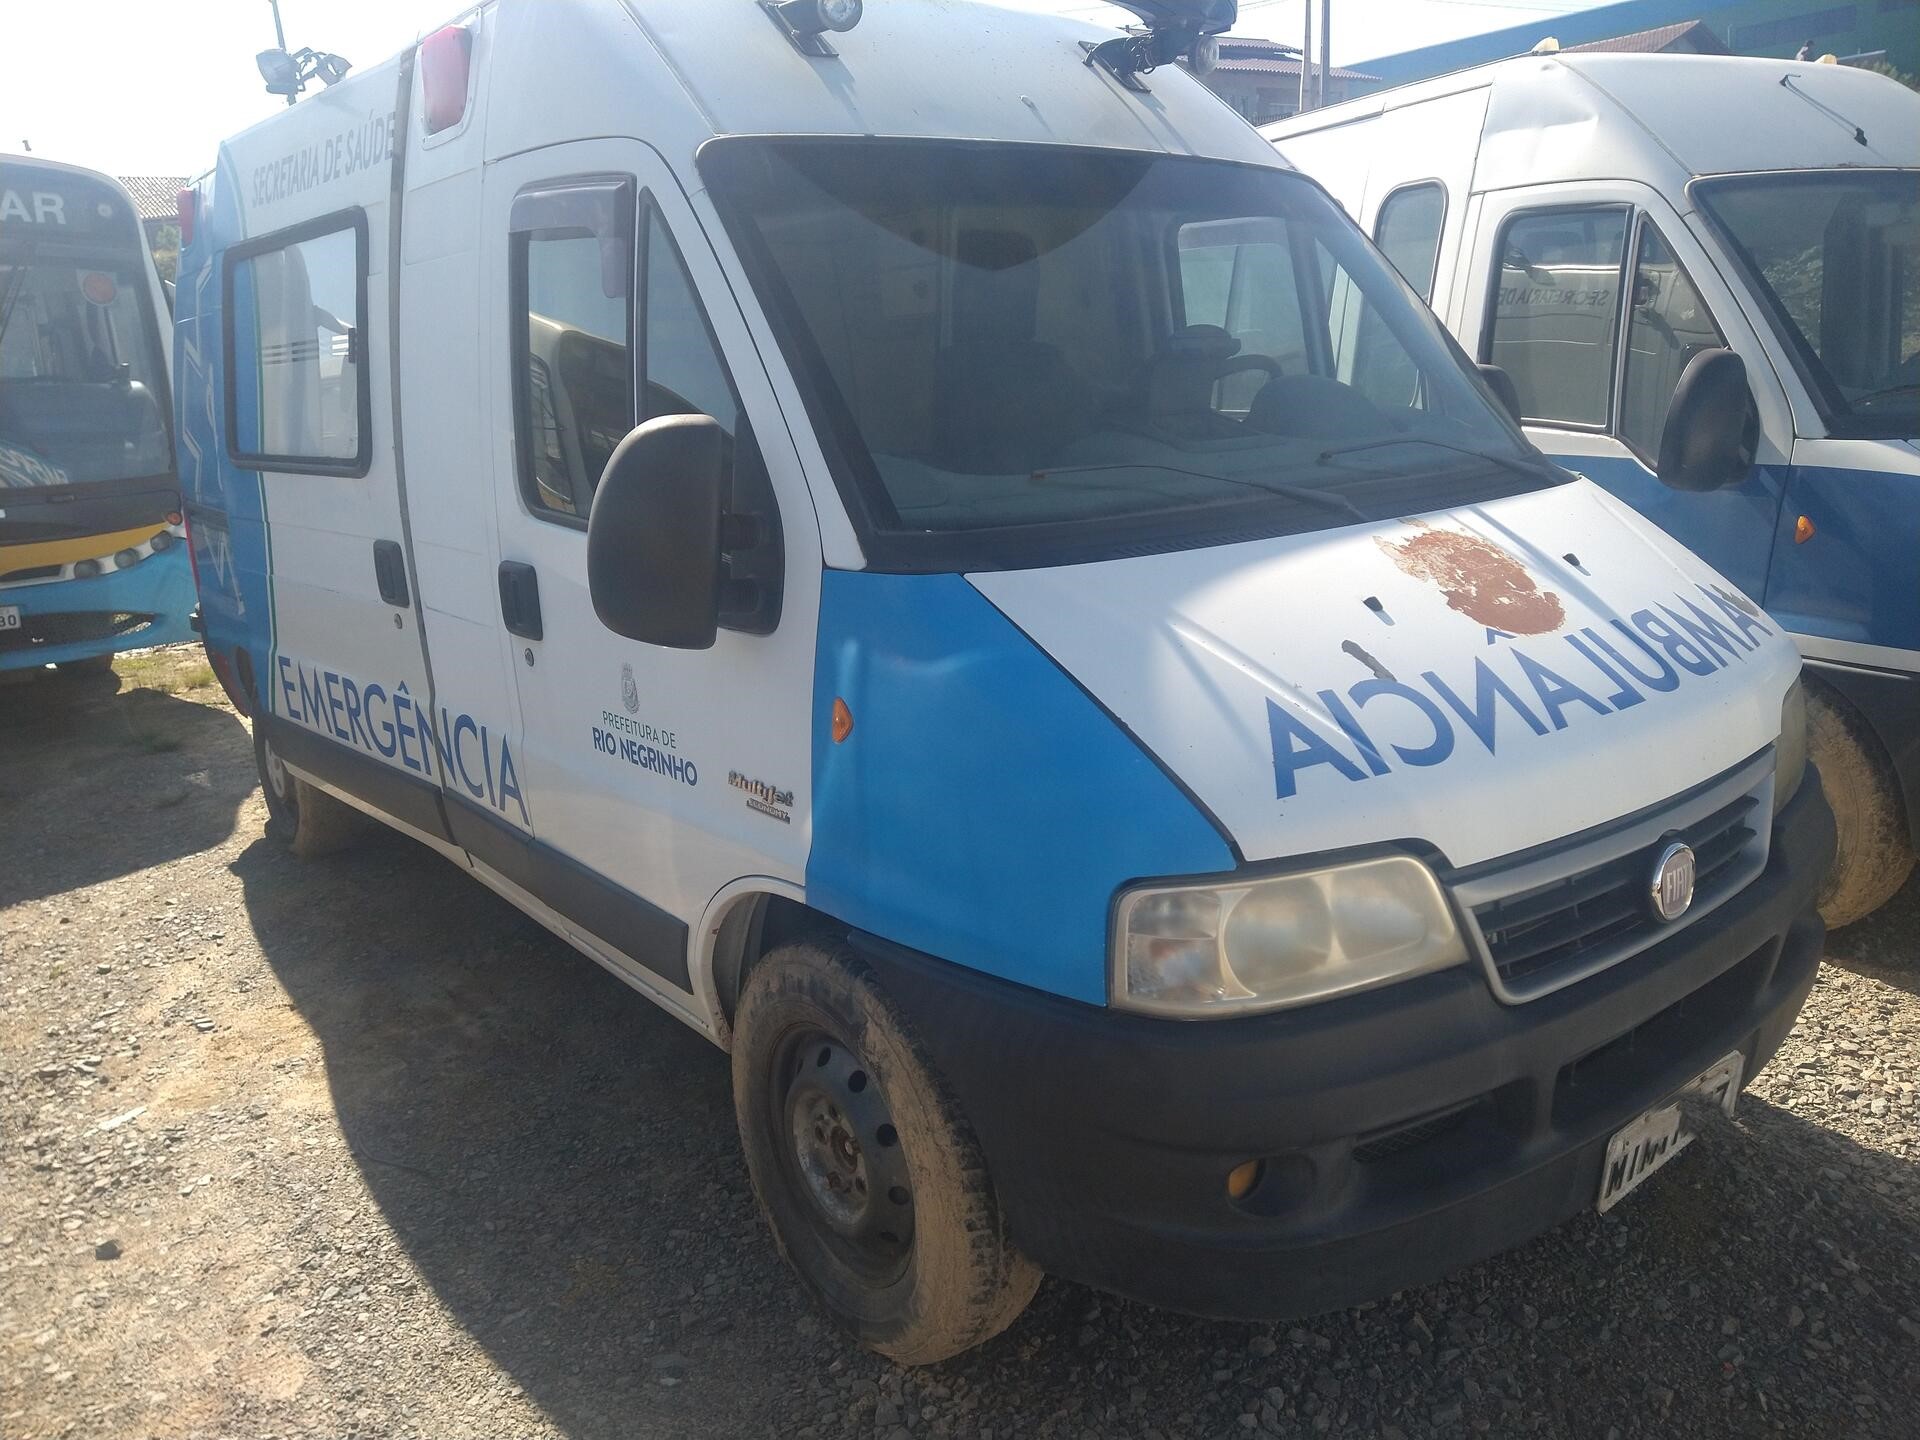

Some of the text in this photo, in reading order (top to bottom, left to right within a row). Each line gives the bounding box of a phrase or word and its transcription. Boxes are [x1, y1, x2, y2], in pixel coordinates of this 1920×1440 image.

[253, 108, 396, 208] SECRETARIA DE SAÚDE
[278, 655, 530, 827] EMERGÊNCIA
[592, 726, 698, 786] RIO NEGRINHO
[602, 710, 676, 749] PREFEITURA DE
[1666, 864, 1690, 904] FIAT
